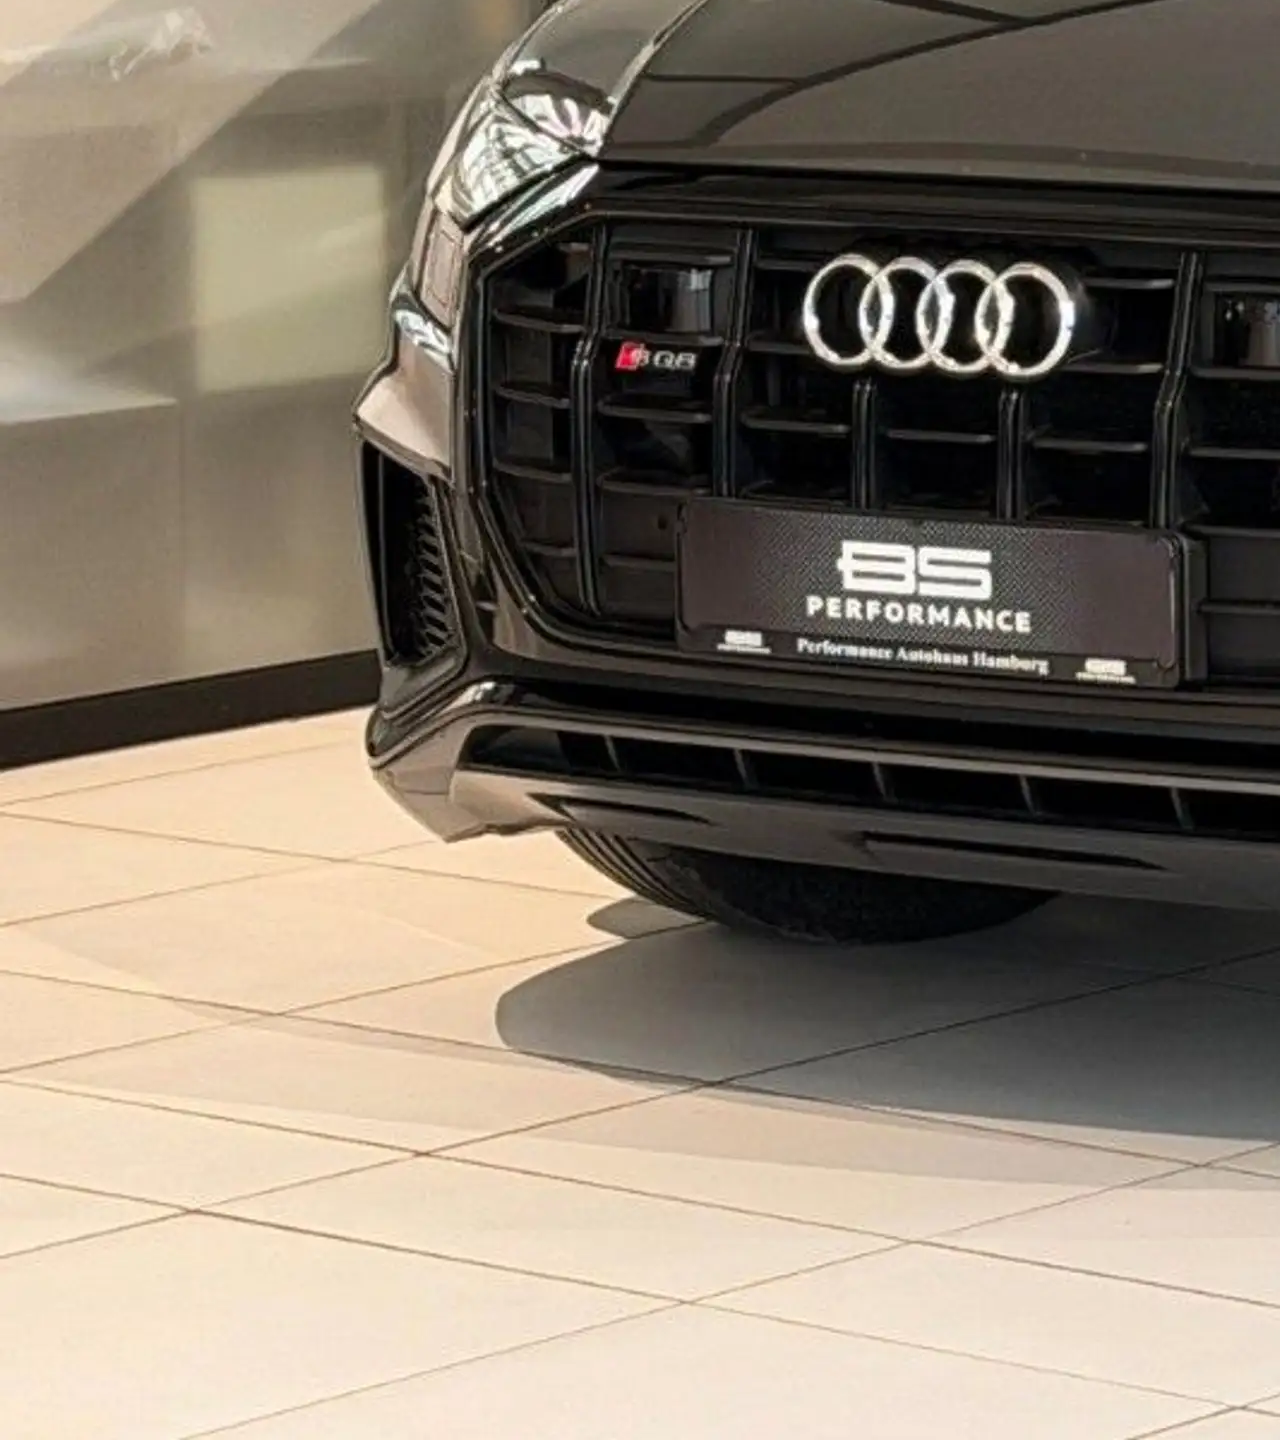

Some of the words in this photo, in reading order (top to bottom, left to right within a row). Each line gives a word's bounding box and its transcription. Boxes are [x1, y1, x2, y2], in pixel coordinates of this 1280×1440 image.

[837, 540, 993, 601] BS
[806, 595, 1032, 633] PERFORMANCE
[797, 638, 894, 660] Performance
[973, 651, 1050, 676] Hamburg
